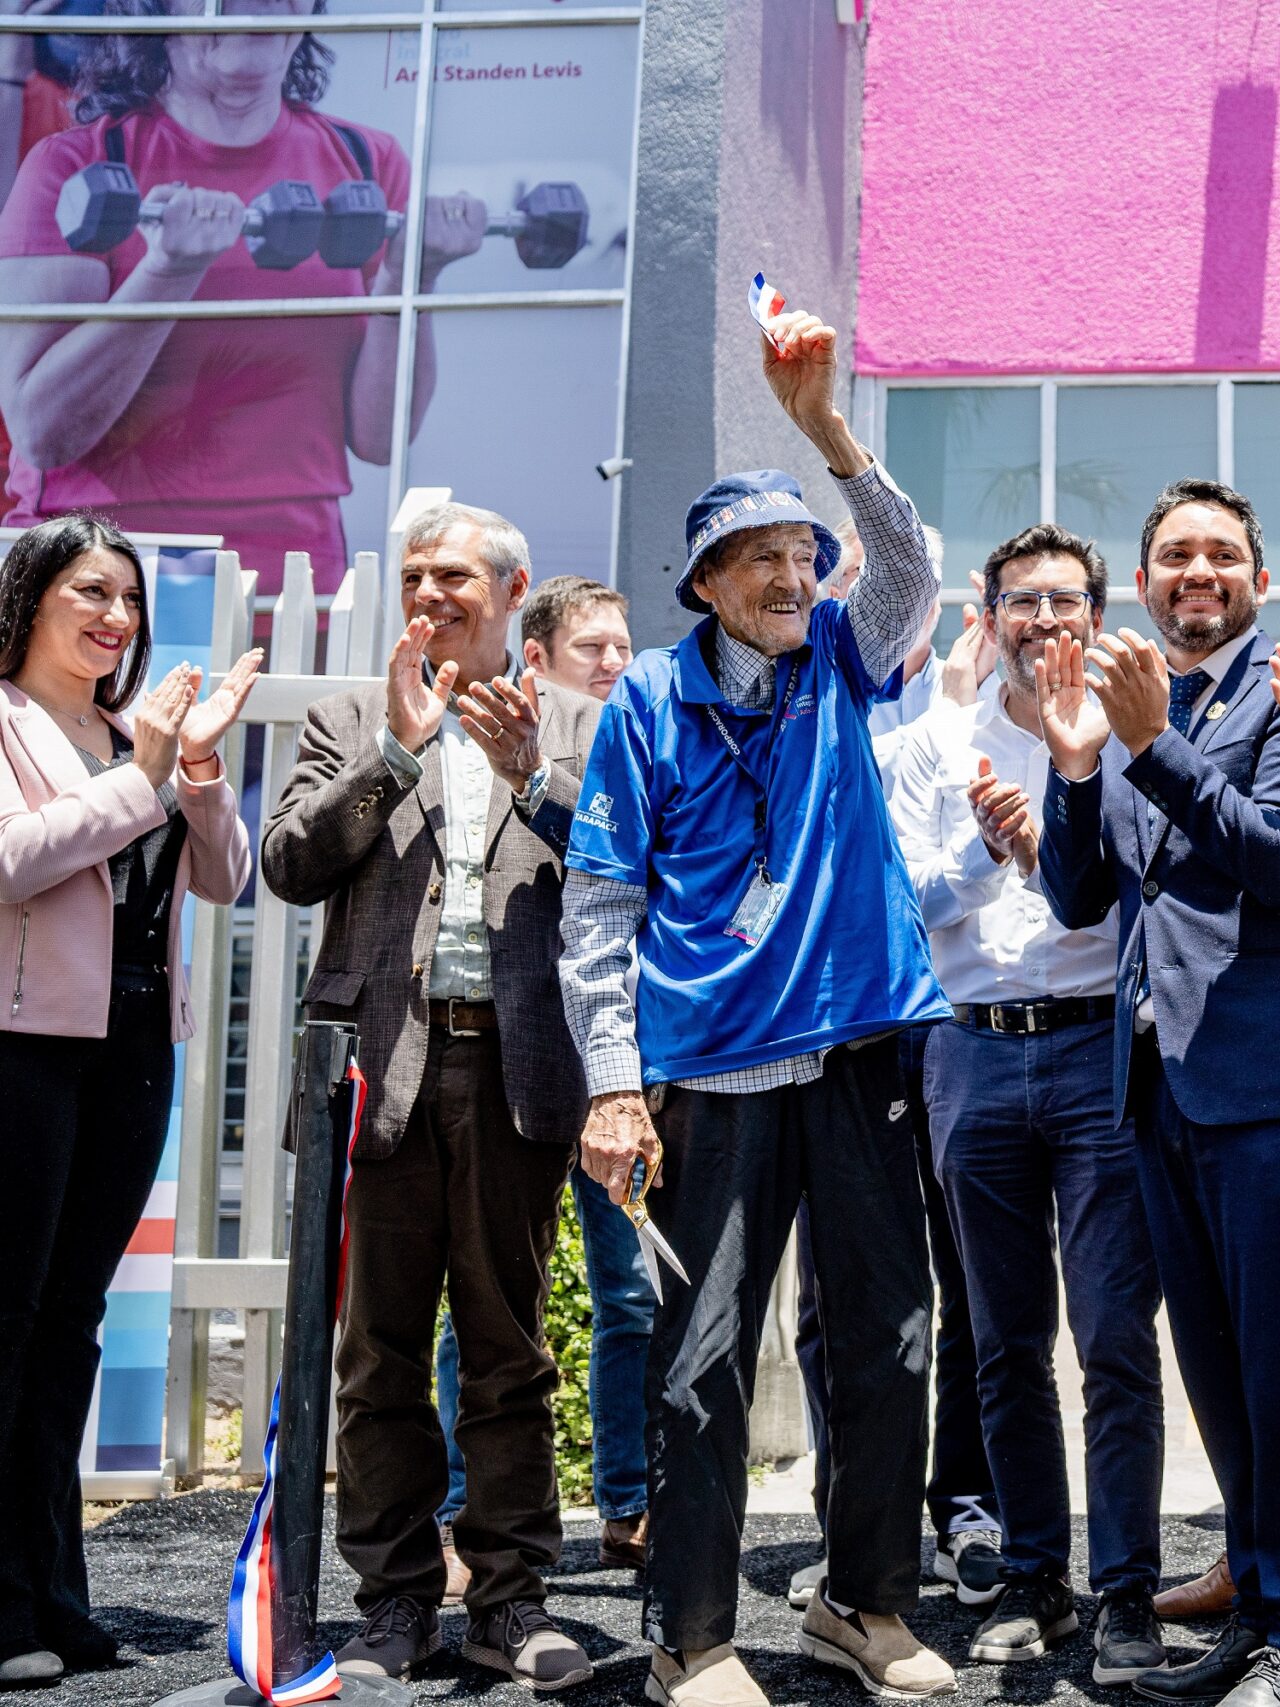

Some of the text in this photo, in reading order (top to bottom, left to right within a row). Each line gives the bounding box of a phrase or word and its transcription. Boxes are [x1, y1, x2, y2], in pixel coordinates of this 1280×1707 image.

[395, 60, 582, 82] Arl Standen Levis
[891, 1099, 906, 1113] NIKE
